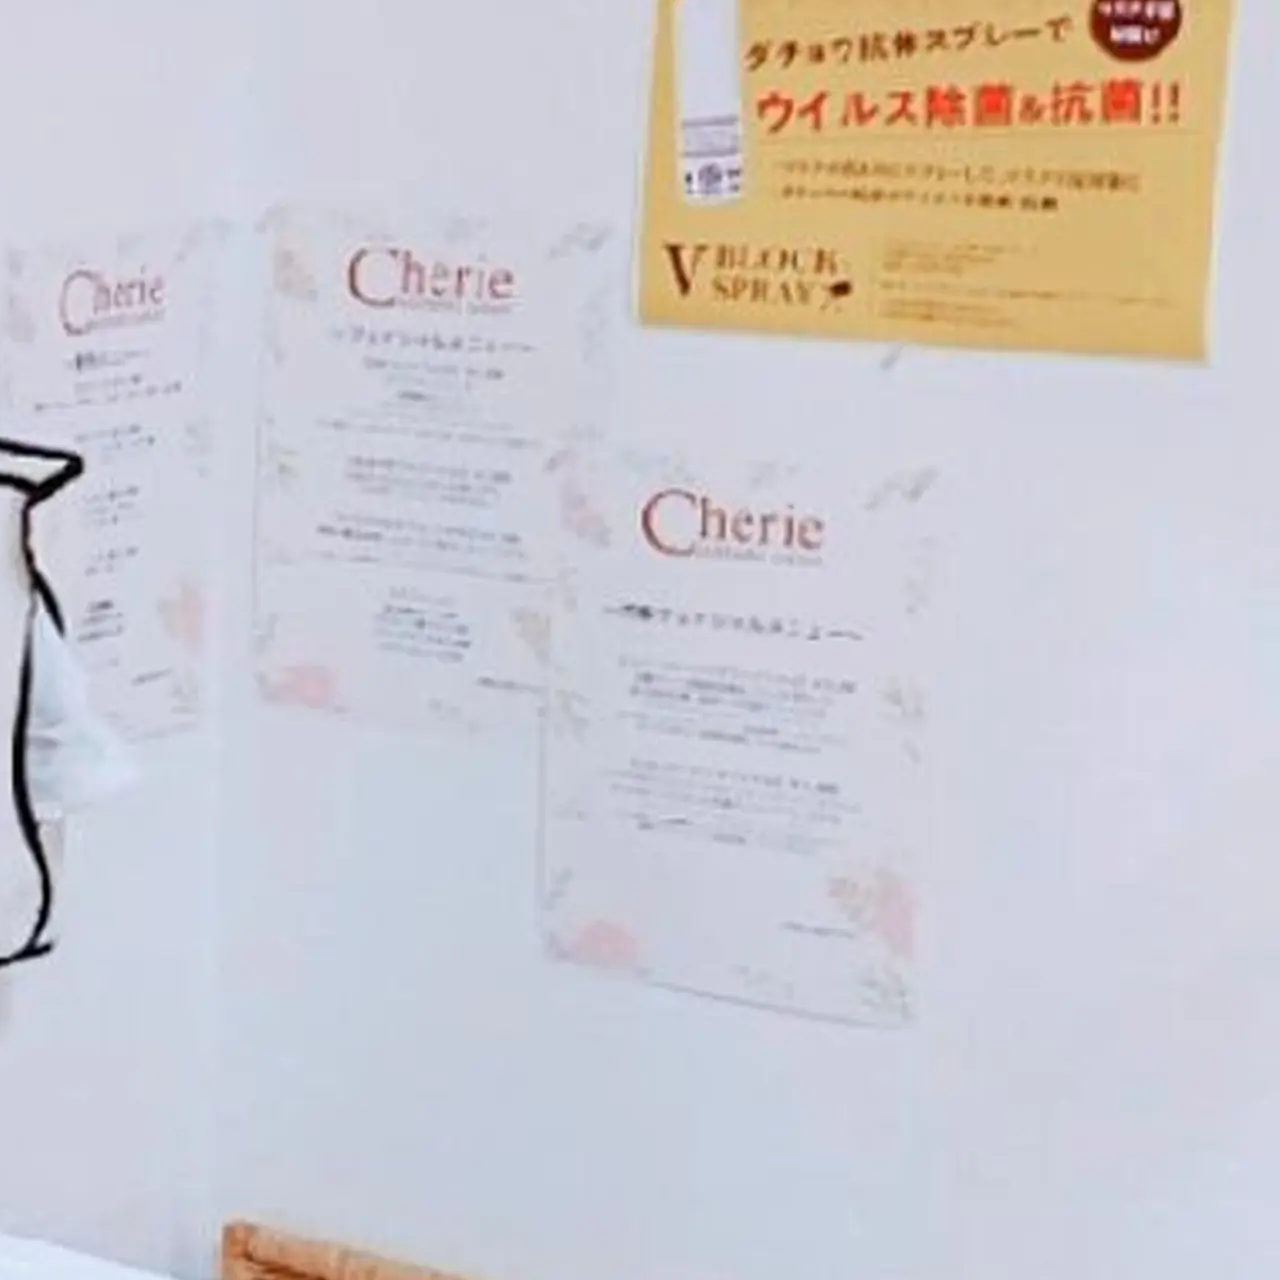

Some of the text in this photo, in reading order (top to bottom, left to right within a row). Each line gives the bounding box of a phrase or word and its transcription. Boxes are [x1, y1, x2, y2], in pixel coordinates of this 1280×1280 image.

[744, 16, 1074, 71] ダチョウ抗体スプレーで
[348, 247, 516, 308] Cherie
[664, 243, 709, 297] V
[715, 245, 839, 274] BLOCK
[59, 267, 166, 336] Cherie
[712, 277, 814, 307] SPRAY
[641, 488, 825, 558] Cherie
